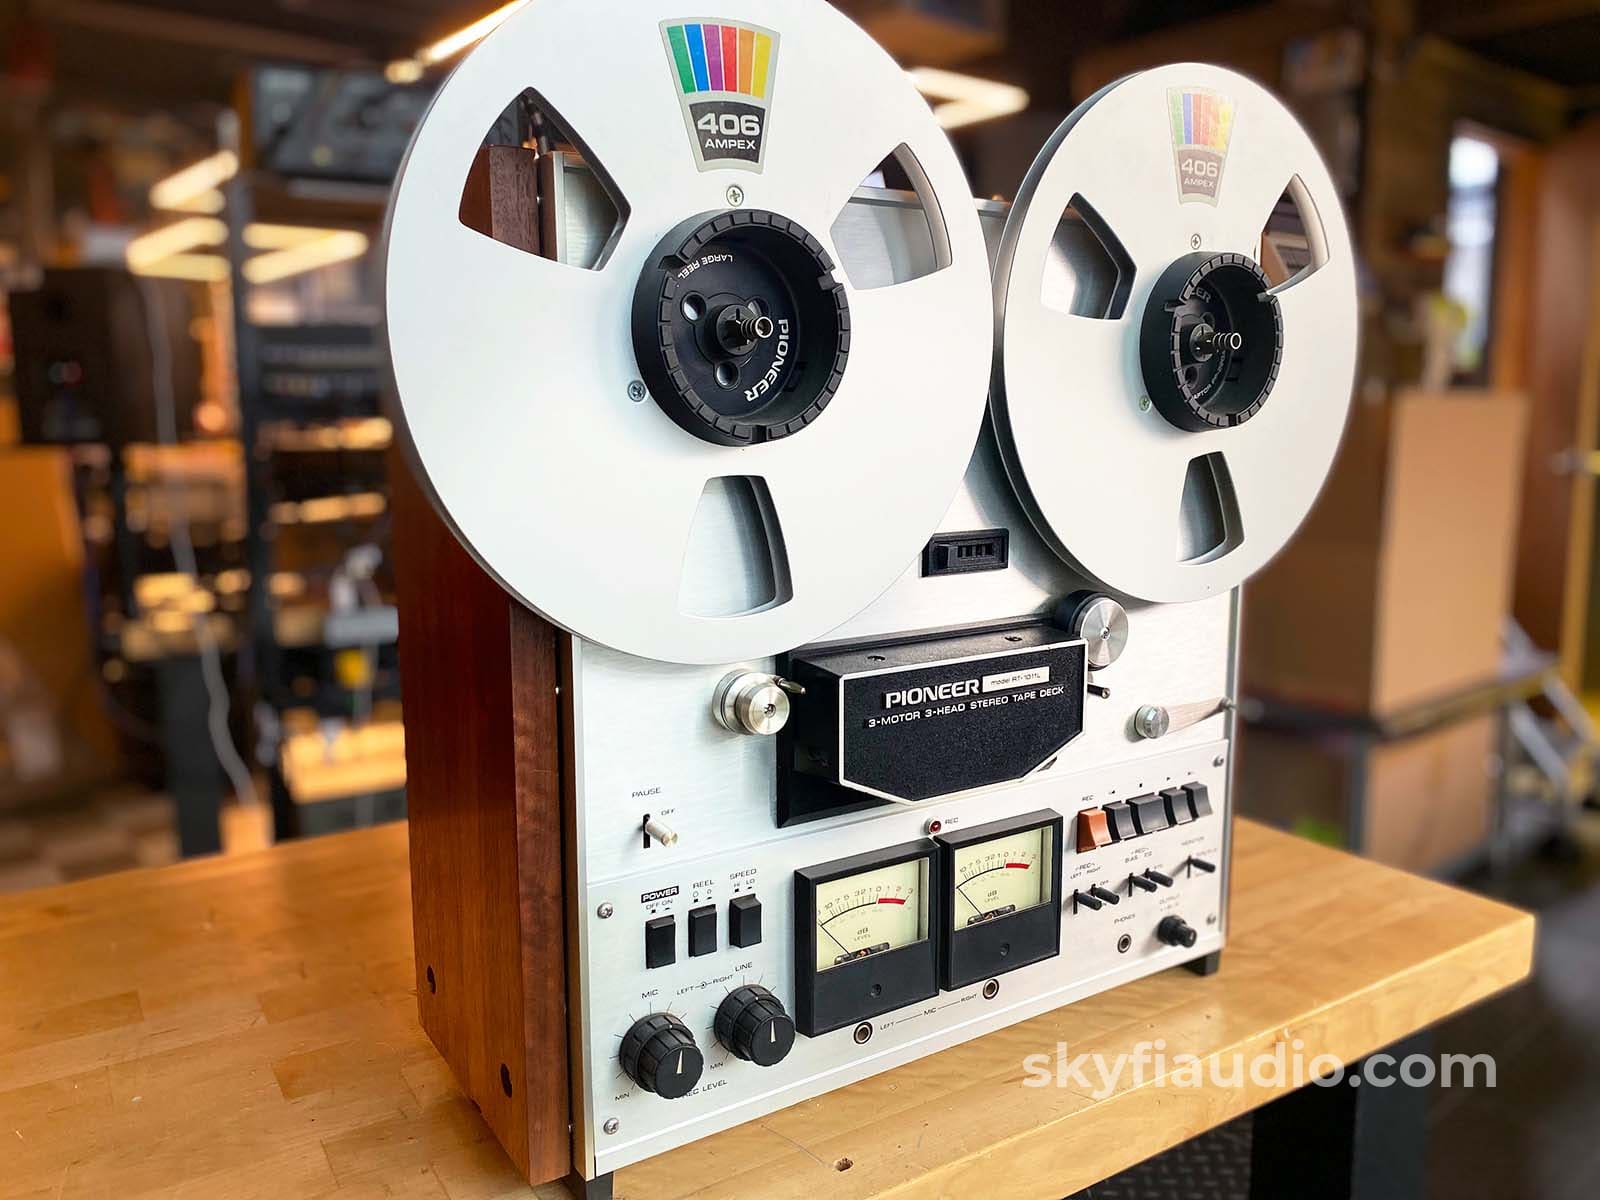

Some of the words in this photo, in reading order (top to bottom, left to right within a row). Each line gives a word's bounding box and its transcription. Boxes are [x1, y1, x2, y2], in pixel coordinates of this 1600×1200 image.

[697, 112, 760, 136] 406
[704, 138, 756, 150] AMPEX
[1181, 158, 1218, 177] 406
[1183, 177, 1215, 189] AMPEX
[701, 254, 733, 265] LARGE
[677, 260, 700, 279] REEL
[744, 318, 789, 402] PIONEER
[885, 679, 980, 709] PIONEER
[868, 710, 921, 728] 3-MOTOR
[925, 703, 966, 718] 3-HEAD
[970, 696, 1009, 711] STEREO
[1013, 690, 1036, 702] TAPE
[1039, 685, 1064, 698] DECK
[631, 787, 662, 798] PAUSE
[661, 808, 675, 816] OFF
[944, 817, 959, 825] REC
[729, 868, 757, 880] SPEED
[692, 879, 714, 889] REEL
[642, 887, 678, 902] POWER
[645, 902, 660, 910] OFF
[1114, 913, 1135, 924] PHONES
[734, 961, 753, 972] LINE
[676, 985, 694, 996] LEFT
[712, 974, 734, 985] RIGHT
[641, 988, 659, 999] MIC
[880, 1022, 895, 1031] LEFT
[923, 1007, 937, 1016] MIC
[960, 993, 978, 1002] RIGHT
[710, 1062, 724, 1071] MIN
[702, 1080, 728, 1092] LEVEL
[614, 1092, 630, 1101] MIN
